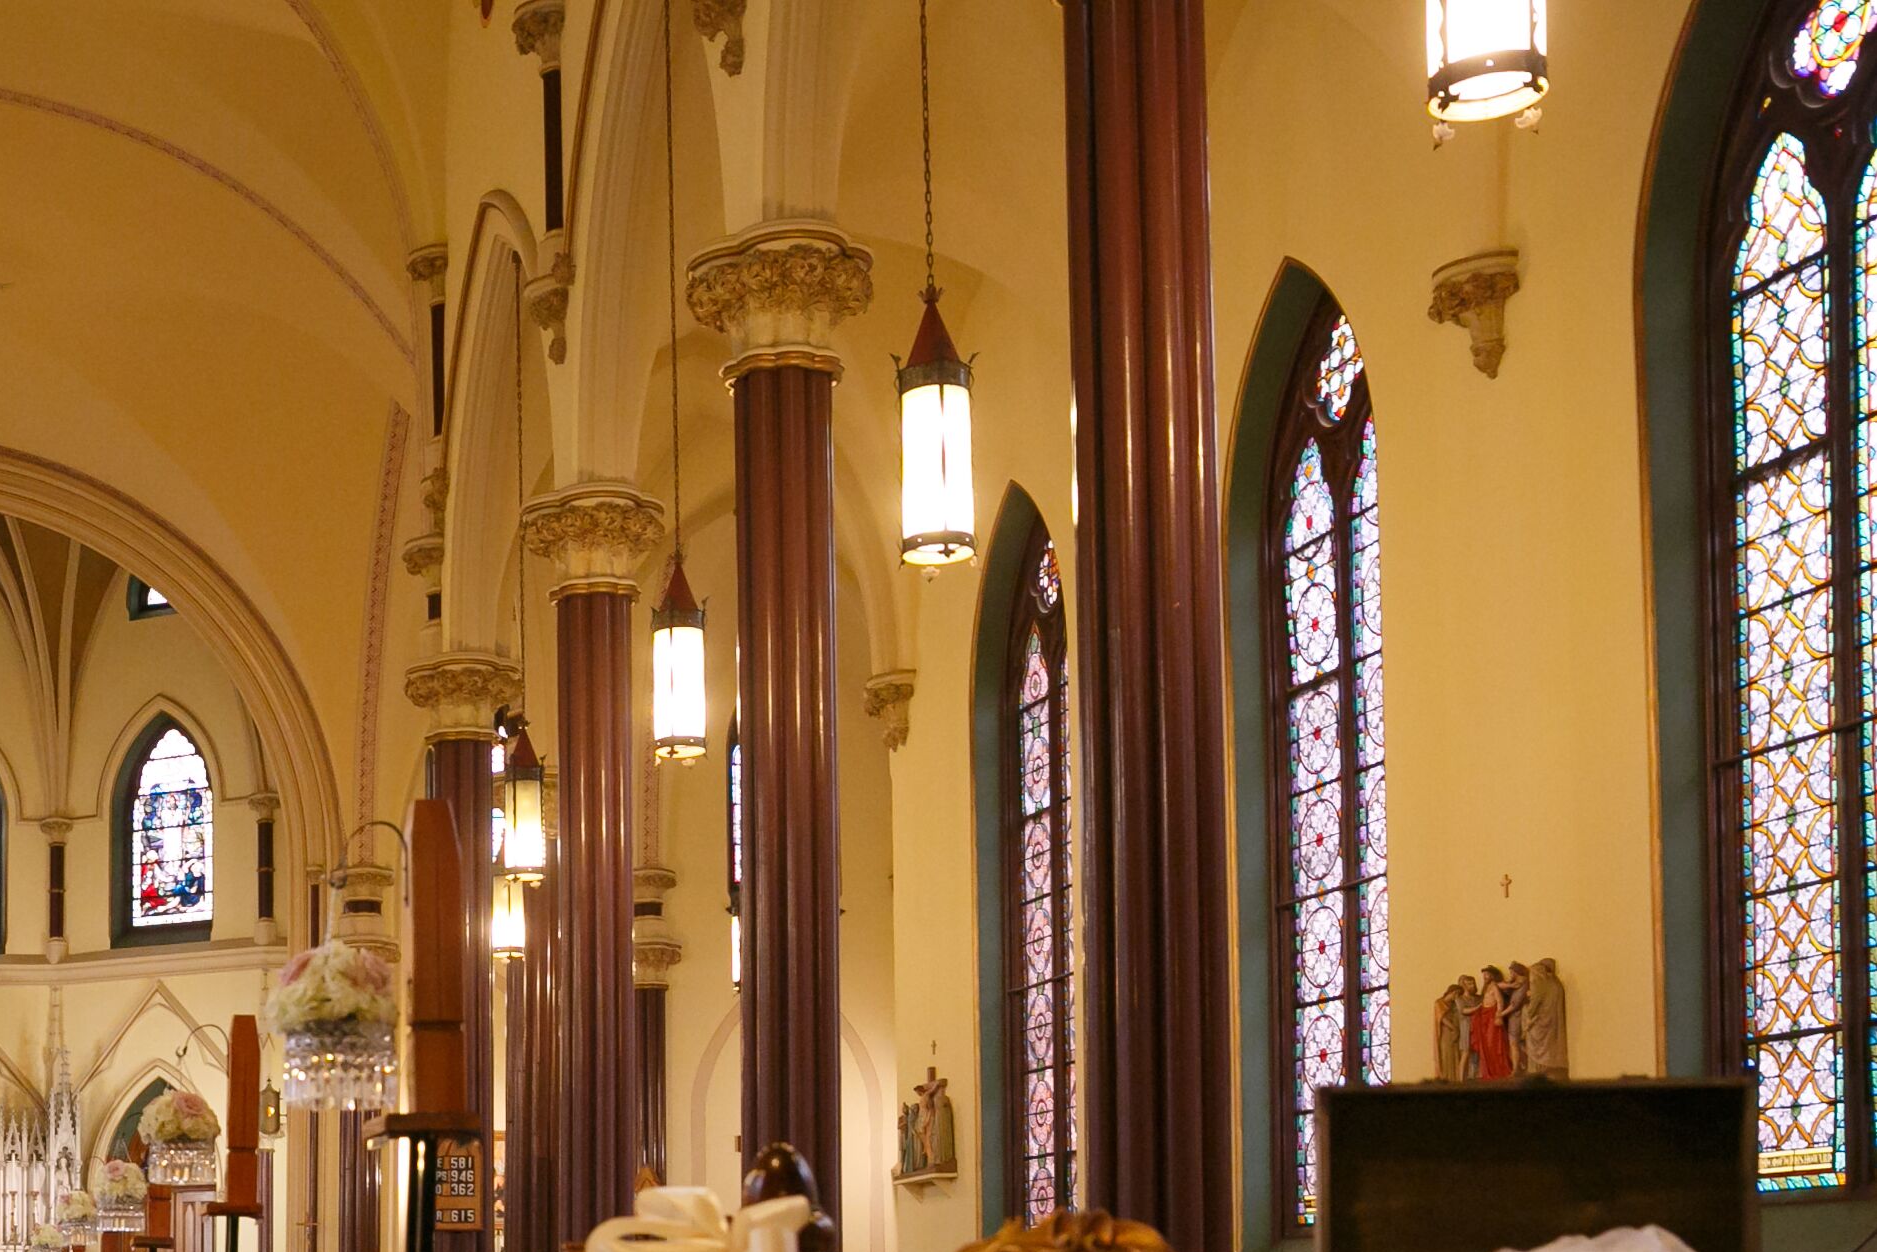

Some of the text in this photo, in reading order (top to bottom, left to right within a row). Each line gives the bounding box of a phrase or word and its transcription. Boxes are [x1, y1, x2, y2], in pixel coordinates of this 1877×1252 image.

[436, 1157, 472, 1168] E 581
[435, 1170, 474, 1182] PS 946
[451, 1184, 474, 1195] 362
[451, 1210, 475, 1222] 615
